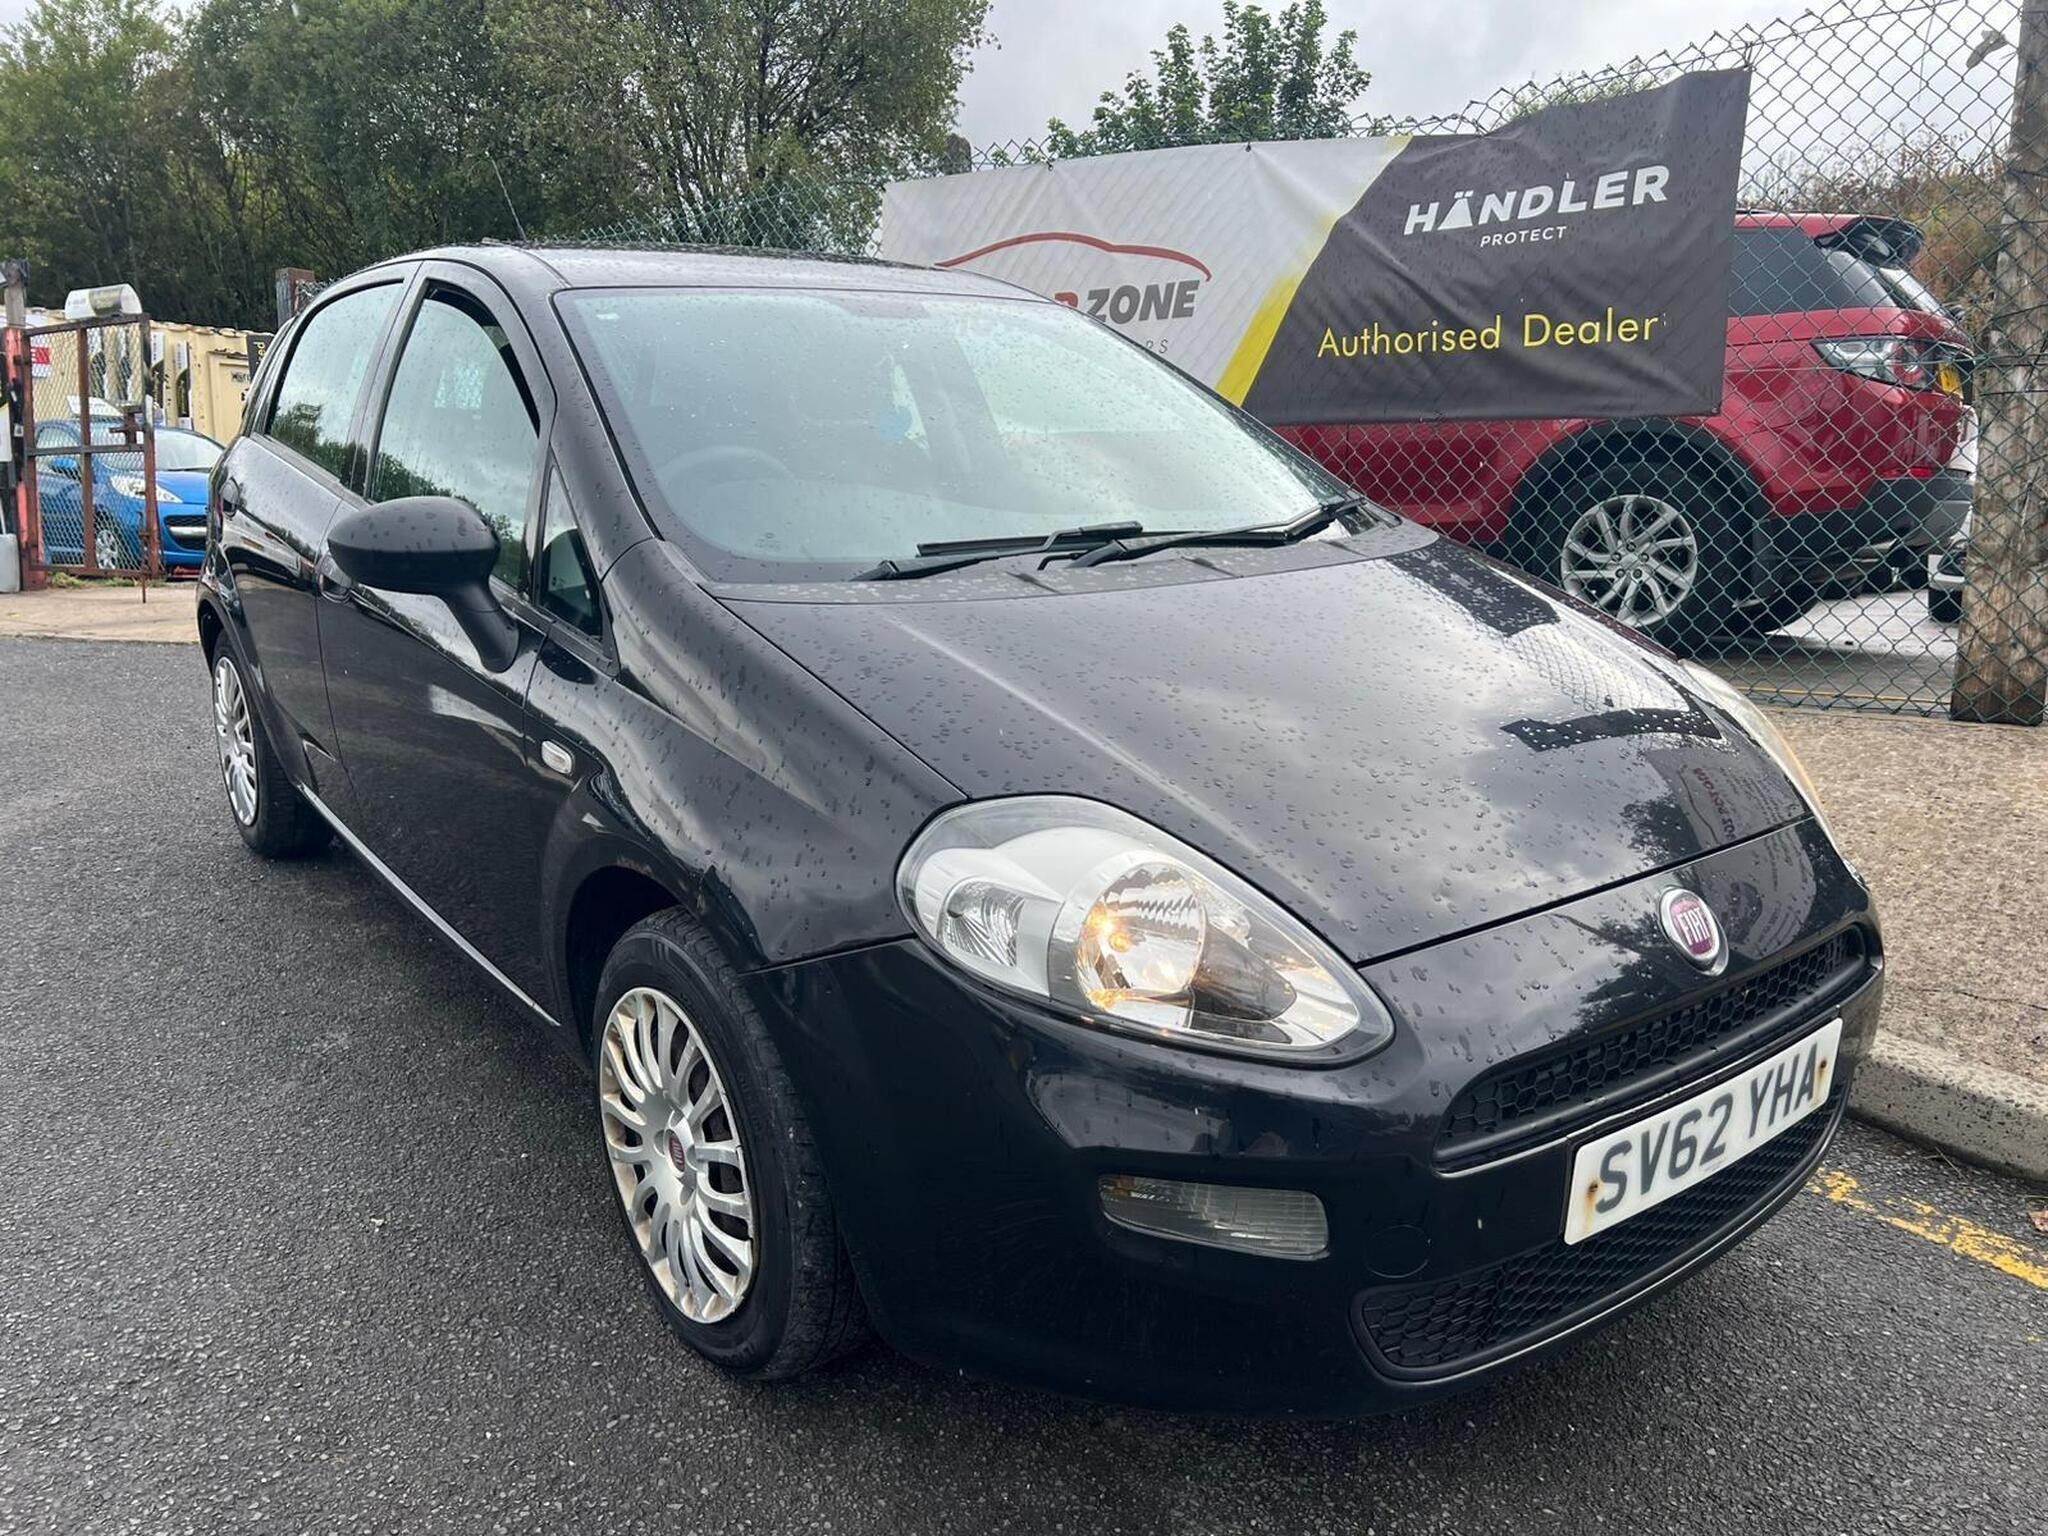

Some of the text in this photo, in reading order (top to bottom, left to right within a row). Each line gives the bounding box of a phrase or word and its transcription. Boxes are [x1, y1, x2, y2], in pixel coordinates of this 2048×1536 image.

[1403, 164, 1670, 235] HÄNDLER
[1479, 225, 1568, 248] PROTECT
[1087, 279, 1200, 324] ZONE
[1317, 307, 1658, 358] Authorised Dealer
[1676, 907, 1711, 946] FIAT
[1595, 1042, 1819, 1214] SV62 YHA
